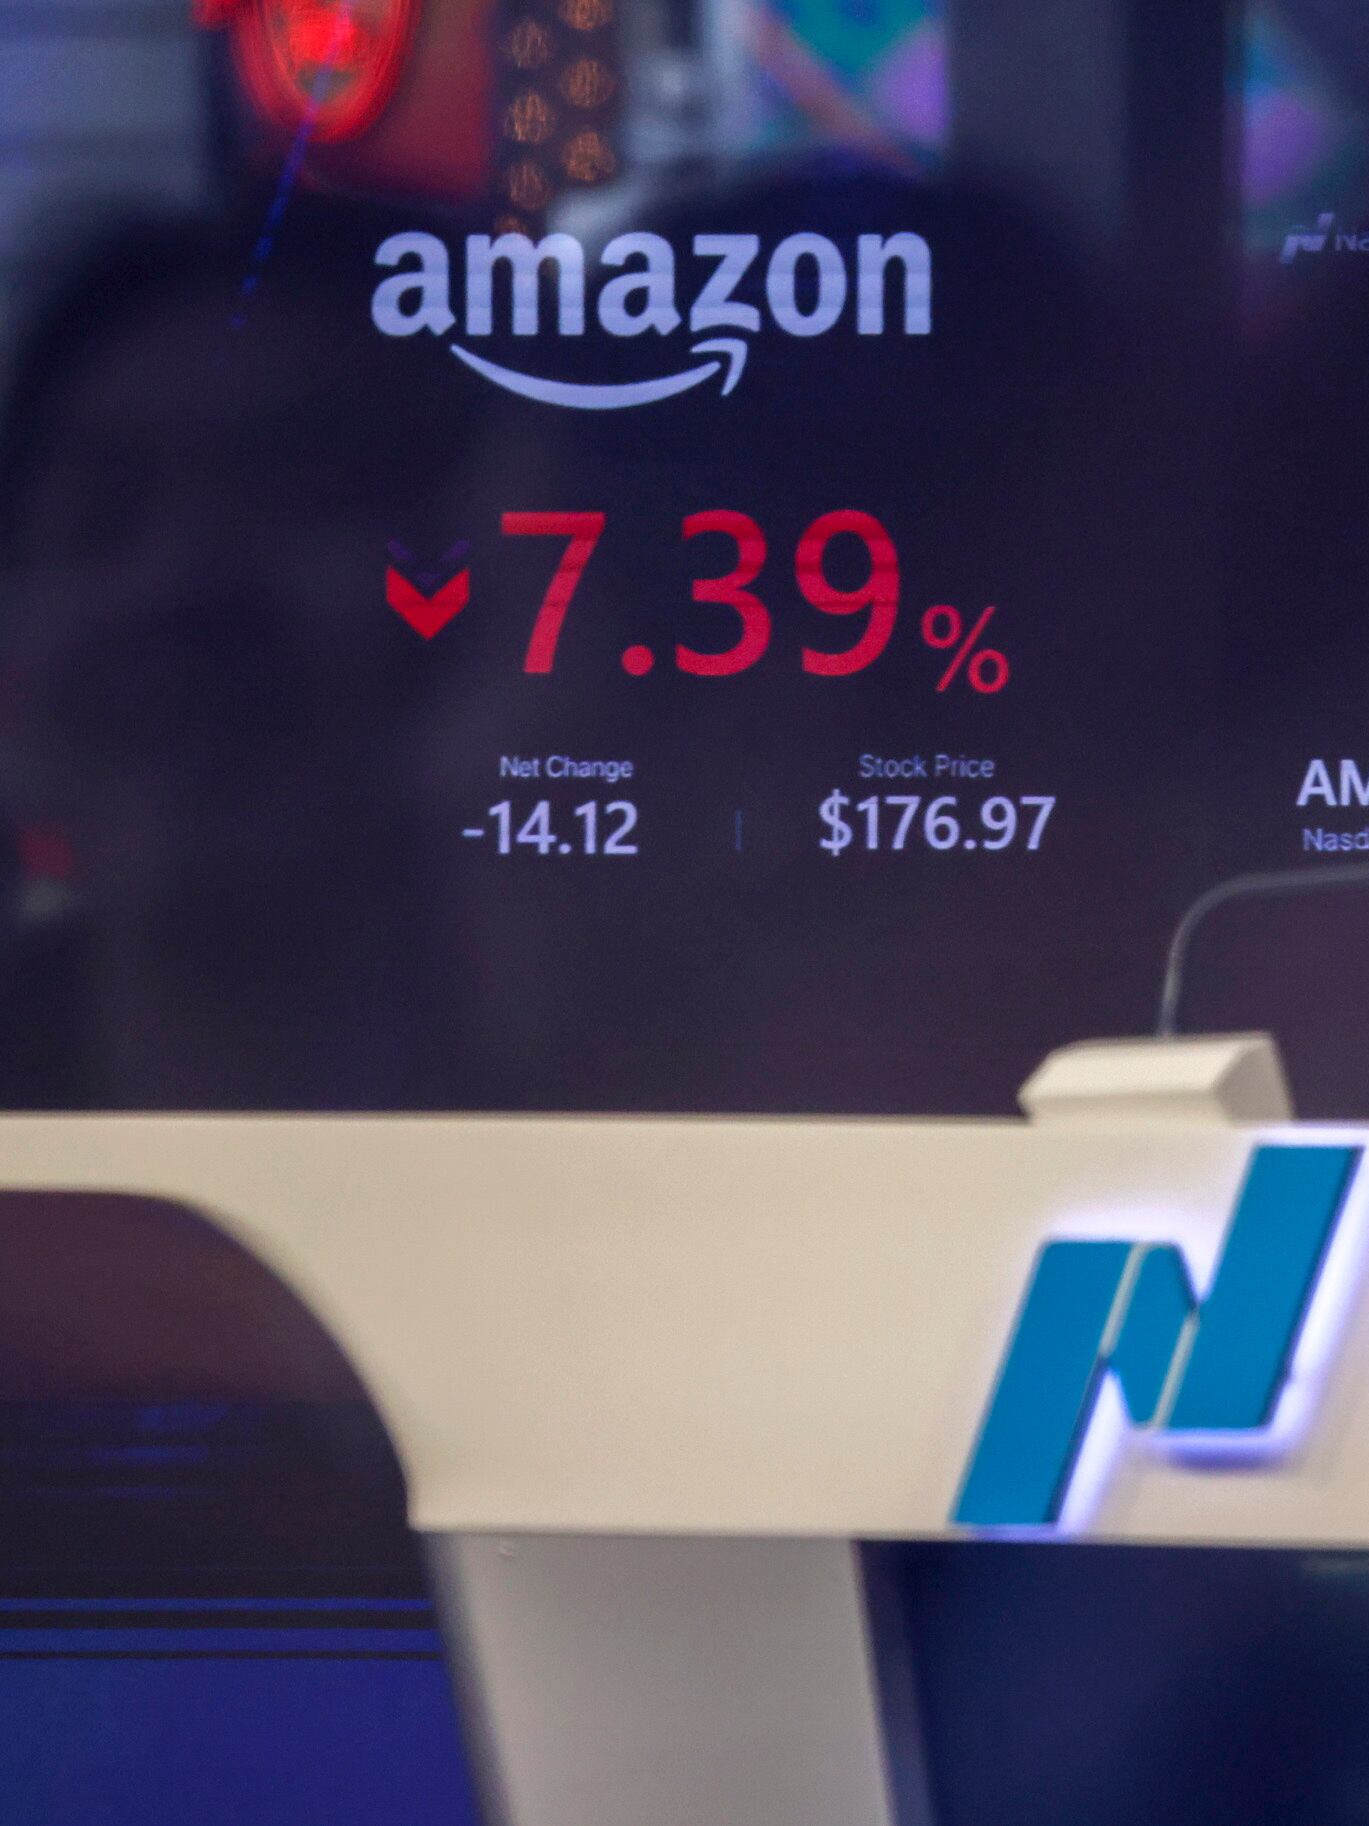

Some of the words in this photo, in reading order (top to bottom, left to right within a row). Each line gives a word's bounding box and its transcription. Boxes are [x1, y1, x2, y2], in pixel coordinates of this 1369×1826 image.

[371, 230, 932, 337] amazon
[501, 508, 1011, 694] 7.39%
[500, 755, 541, 778] Net
[545, 754, 635, 784] Change
[858, 753, 928, 779] Stock
[934, 753, 996, 779] Price
[461, 800, 639, 855] -14.12
[818, 788, 1057, 857] $176.97
